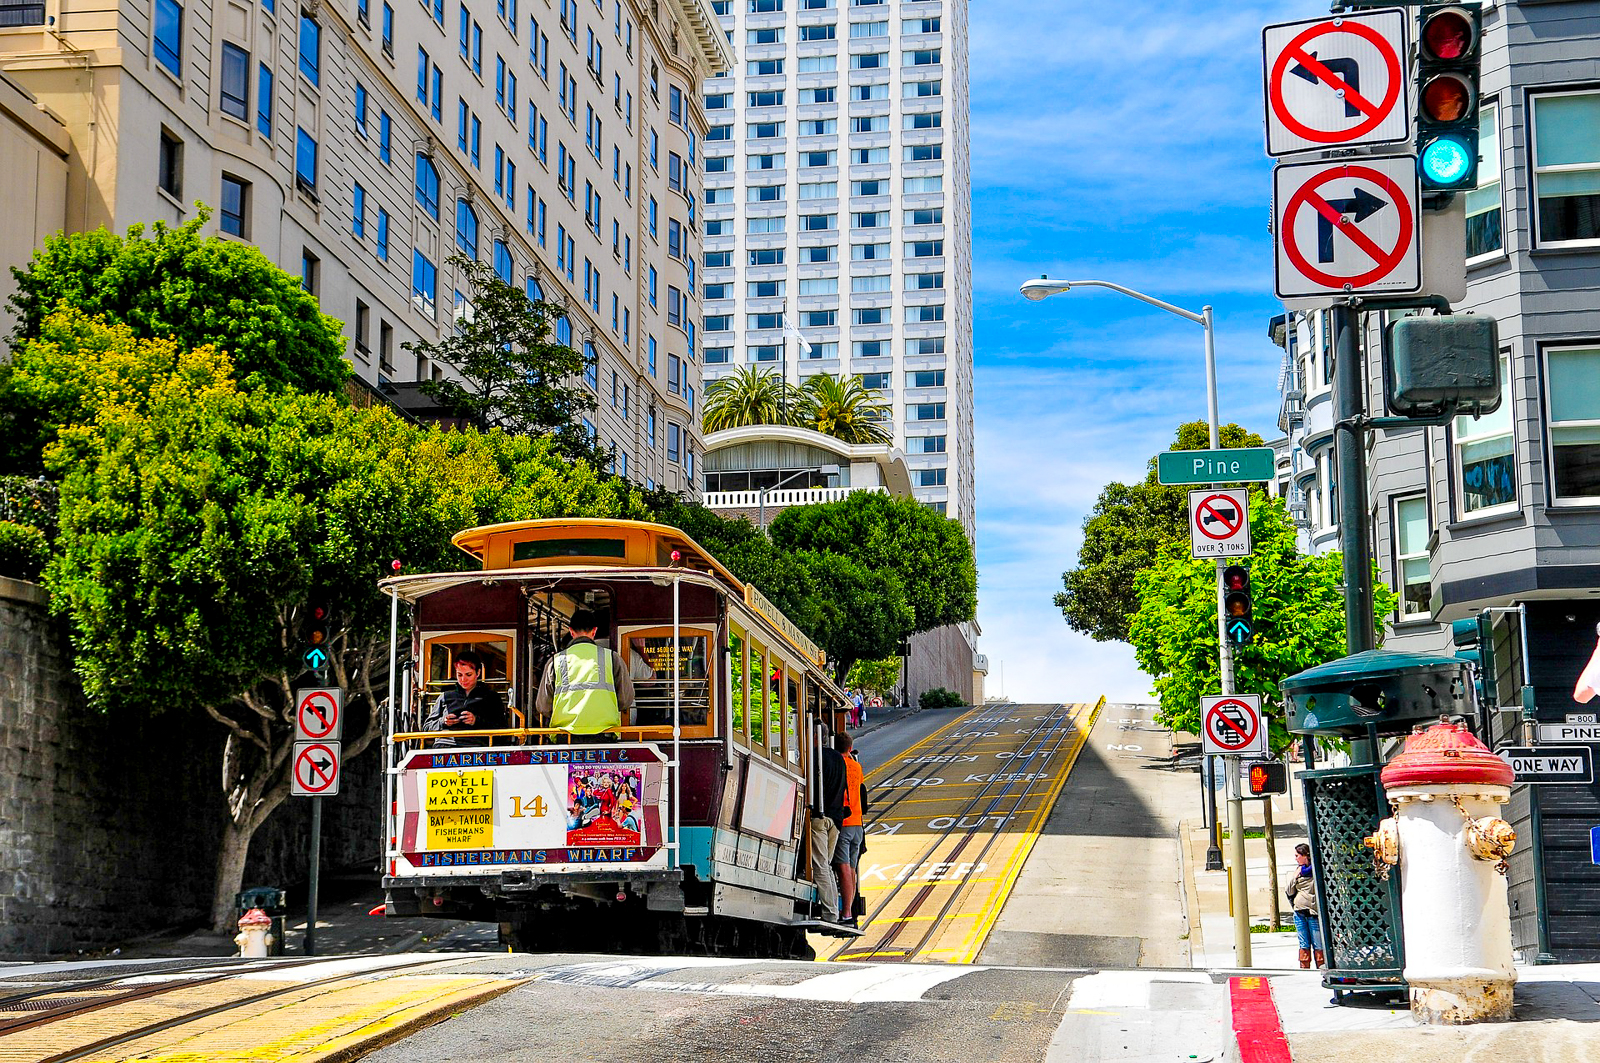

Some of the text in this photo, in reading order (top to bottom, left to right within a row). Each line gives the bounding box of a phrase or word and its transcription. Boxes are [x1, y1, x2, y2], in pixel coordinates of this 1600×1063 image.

[1193, 458, 1240, 475] Pine
[1196, 542, 1245, 554] OVER 3 TONS
[753, 590, 780, 626] POWELL
[643, 646, 656, 654] FARE
[681, 645, 694, 653] WAY
[1577, 715, 1593, 723] 800
[1561, 728, 1600, 739] PINE
[1106, 743, 1143, 752] NO
[432, 751, 511, 768] MARKET
[530, 749, 611, 764] STREET
[995, 751, 1057, 760] OUT
[1512, 758, 1579, 772] ONE WAY
[431, 777, 489, 788] POWELL
[871, 777, 946, 787] OUT
[963, 772, 1049, 783] KEEP
[446, 787, 474, 795] AND
[429, 794, 489, 805] MARKET
[509, 794, 548, 818] 14
[430, 815, 445, 827] BAY
[459, 813, 490, 826] TAYLOR
[927, 816, 1015, 830] OUT
[435, 826, 485, 836] FISHERMANS
[446, 835, 472, 843] WHARF
[422, 848, 637, 866] FISHERMANS WHARF
[860, 861, 988, 881] KEEP
